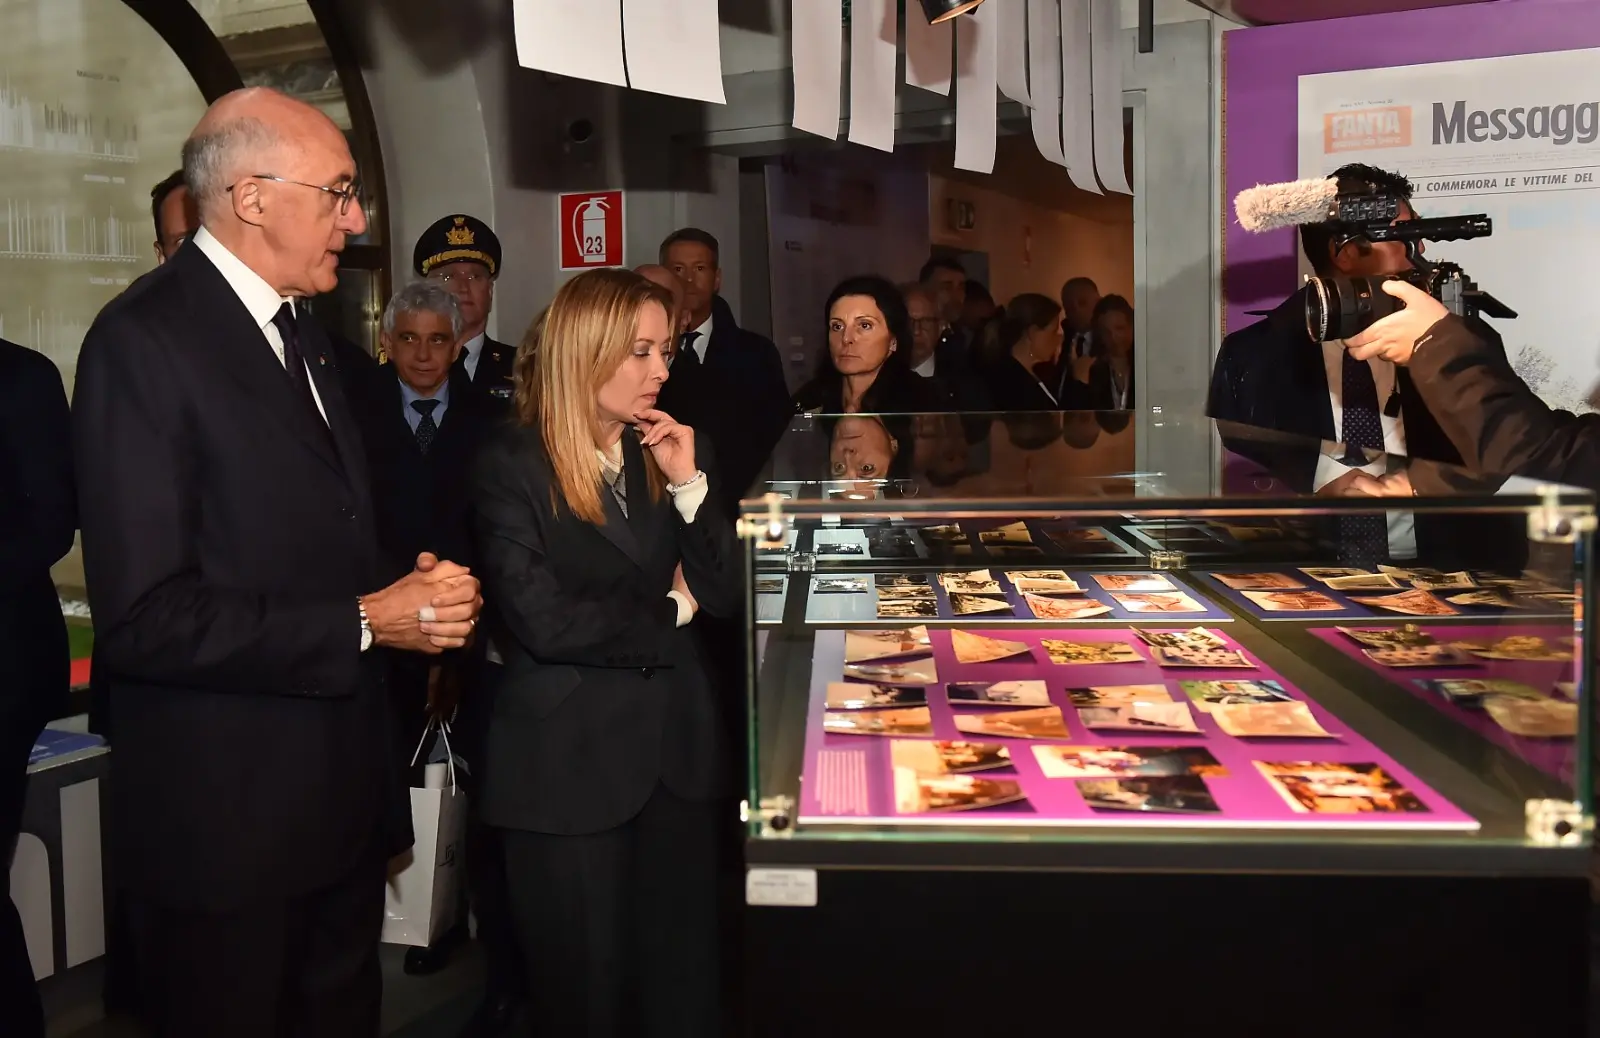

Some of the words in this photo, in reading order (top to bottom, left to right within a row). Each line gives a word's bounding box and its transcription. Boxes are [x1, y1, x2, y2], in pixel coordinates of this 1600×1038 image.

[1331, 110, 1400, 139] FANTA
[1426, 178, 1498, 193] COMMEMORA
[1504, 177, 1517, 187] LE
[1523, 174, 1568, 186] VITTIME
[1574, 172, 1594, 183] DEL
[585, 235, 603, 254] 23
